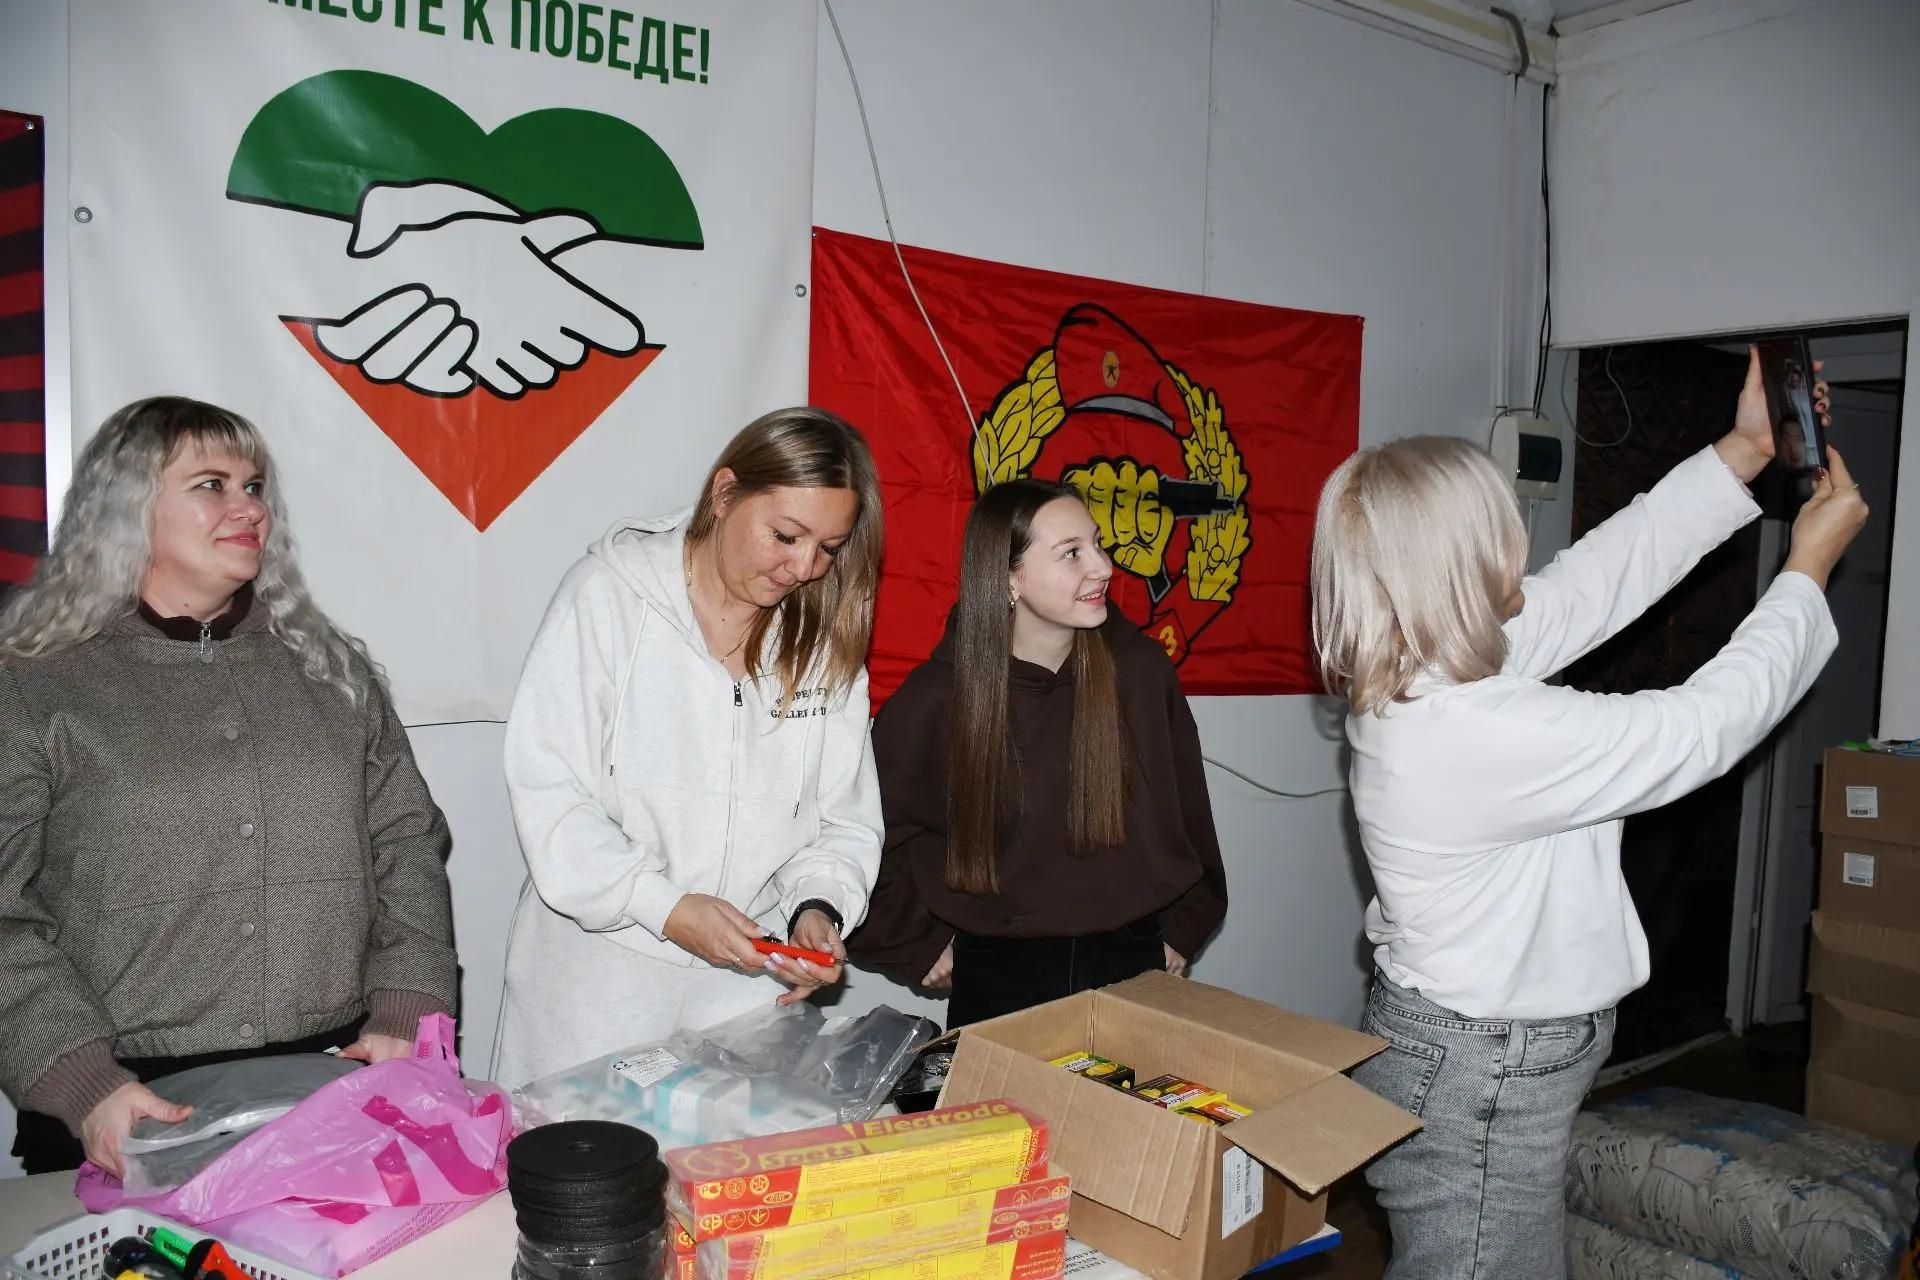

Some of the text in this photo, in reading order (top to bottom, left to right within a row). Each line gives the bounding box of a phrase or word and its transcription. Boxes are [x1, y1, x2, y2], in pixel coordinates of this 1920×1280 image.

[463, 0, 494, 45] К
[510, 0, 710, 85] ПОБЕДЕ!
[763, 1145, 855, 1169] Spets
[863, 1103, 1010, 1137] Electrode
